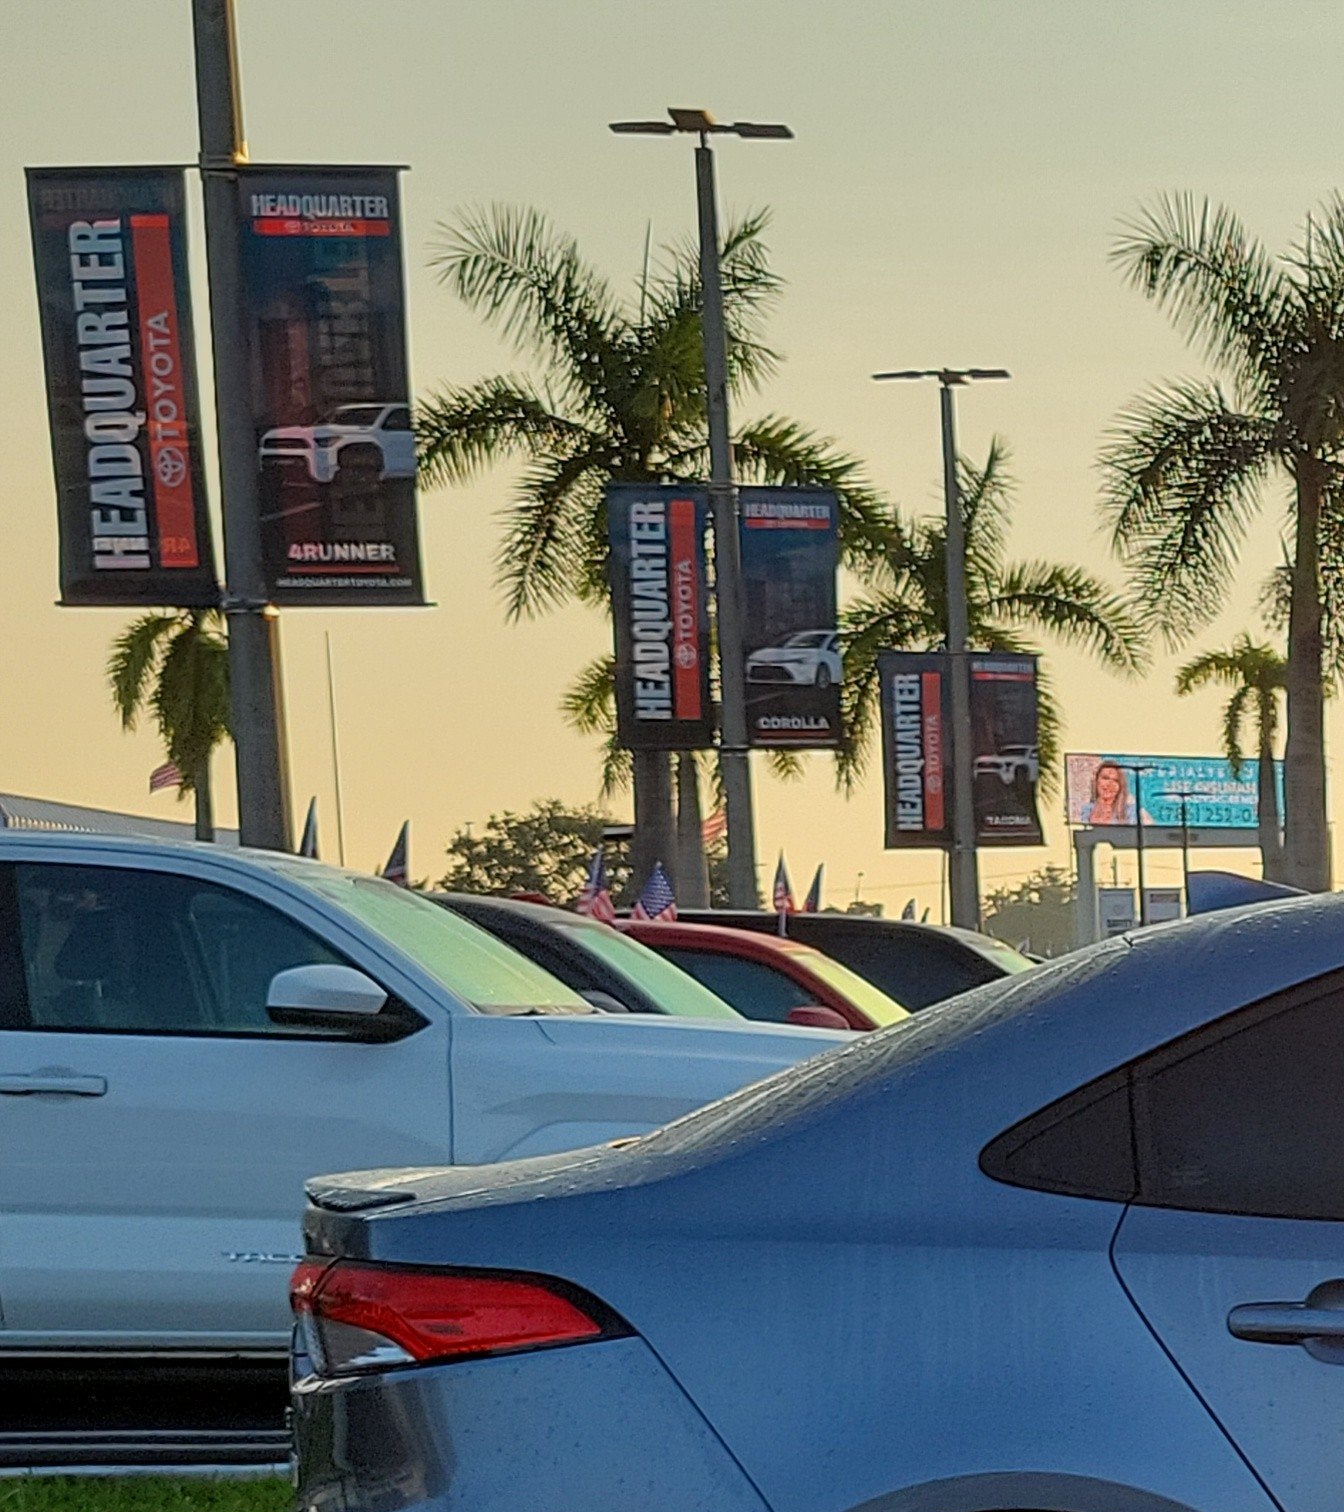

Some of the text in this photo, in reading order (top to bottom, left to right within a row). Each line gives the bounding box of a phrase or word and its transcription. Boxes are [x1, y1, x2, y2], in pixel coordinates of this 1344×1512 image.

[252, 194, 389, 219] HEADQUARTER
[69, 217, 151, 570] HEADQUARTER
[147, 311, 179, 441] TOYOTA
[288, 543, 396, 561] 4RUNNER
[675, 560, 693, 640] TOYOTA
[630, 501, 673, 720] HEADQUARTER
[758, 715, 831, 730] COROLLA
[894, 674, 925, 830] HEADQUARTER
